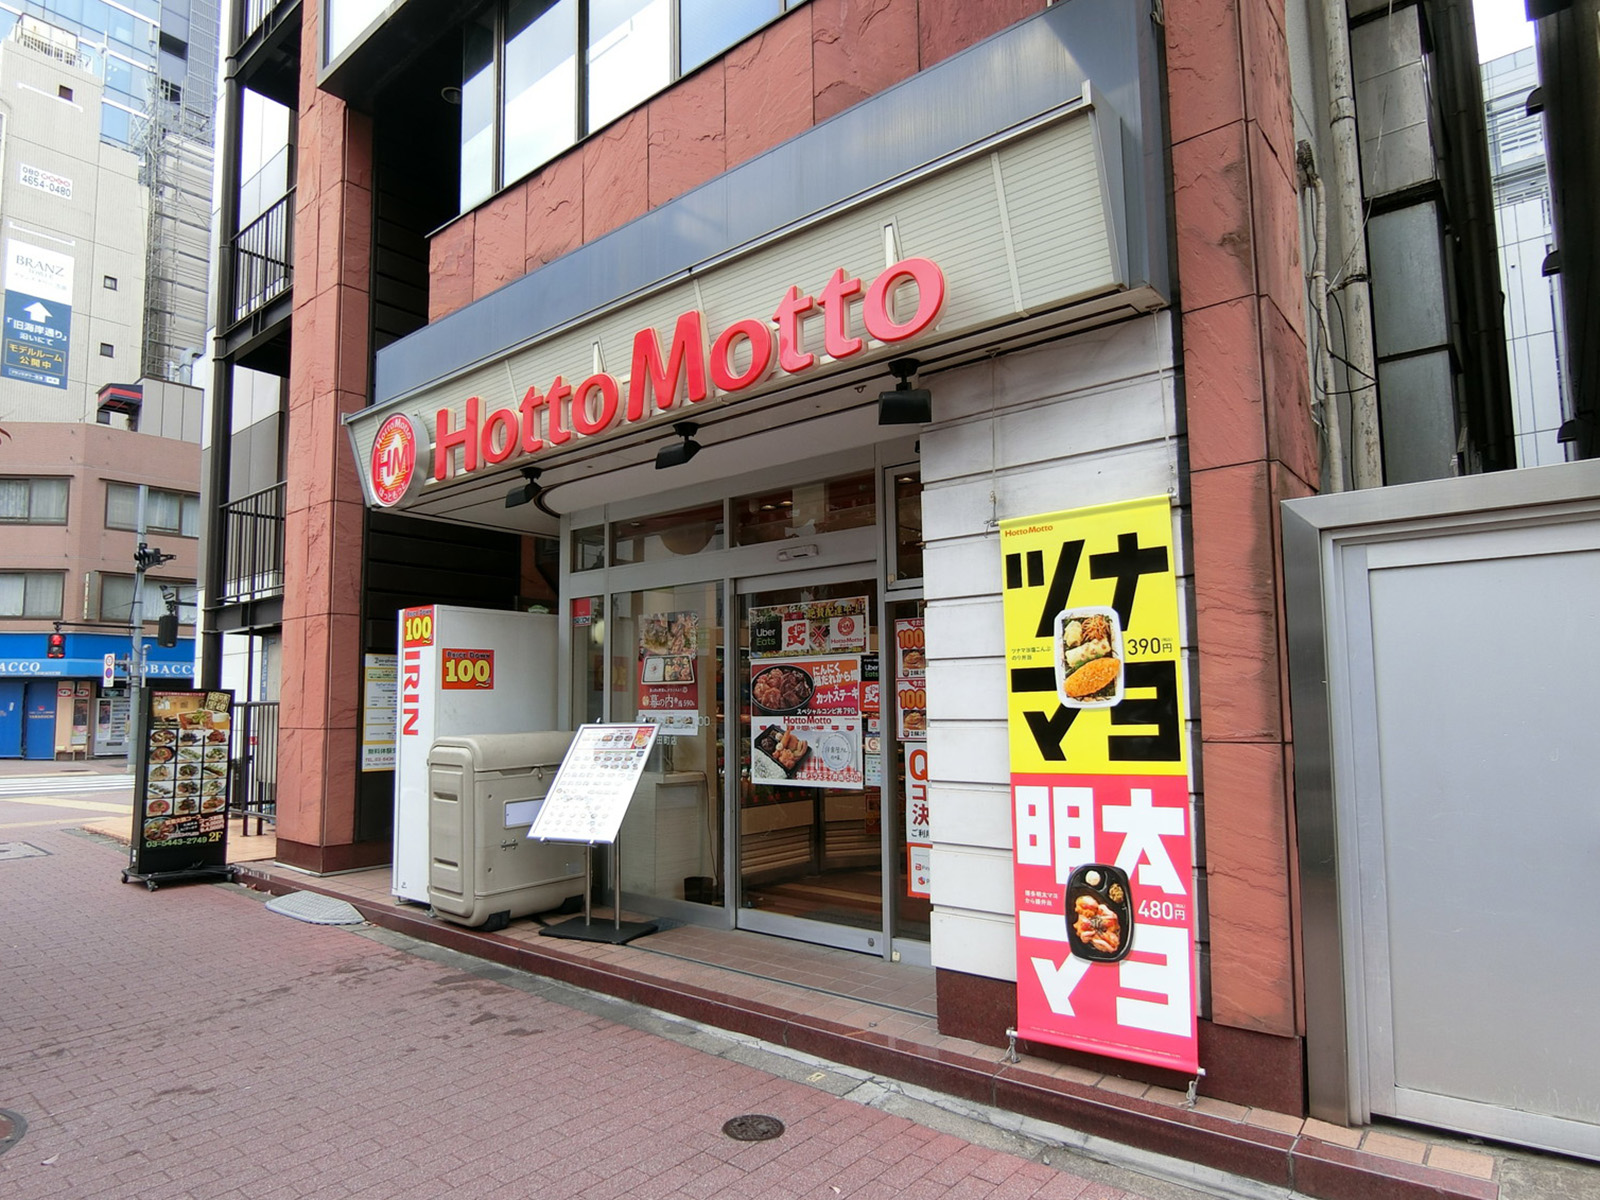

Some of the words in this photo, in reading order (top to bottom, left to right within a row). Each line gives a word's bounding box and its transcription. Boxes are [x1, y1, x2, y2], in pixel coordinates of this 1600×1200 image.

[22, 175, 71, 197] 4654-0480
[16, 255, 65, 277] BRANZ
[20, 332, 54, 346] 沿いにて
[9, 343, 63, 363] モデルルーム
[20, 356, 52, 369] 公開中
[1005, 525, 1053, 537] HottoMotto
[1005, 532, 1169, 639] ツナ
[405, 616, 432, 641] 100
[756, 628, 776, 637] Uber
[756, 638, 776, 646] Eats
[1127, 637, 1173, 656] 390円
[446, 659, 490, 682] 100
[813, 662, 840, 676] にんにく
[649, 694, 683, 708] 幕の内弁当
[816, 687, 859, 705] カットステーキ
[1011, 660, 1182, 761] マヨ
[783, 715, 832, 725] HottoMotto
[656, 736, 677, 745] 田町店
[209, 831, 223, 842] 2F
[1014, 785, 1187, 895] 明太
[1137, 900, 1185, 921] 480円
[1019, 910, 1192, 1038] マヨ
